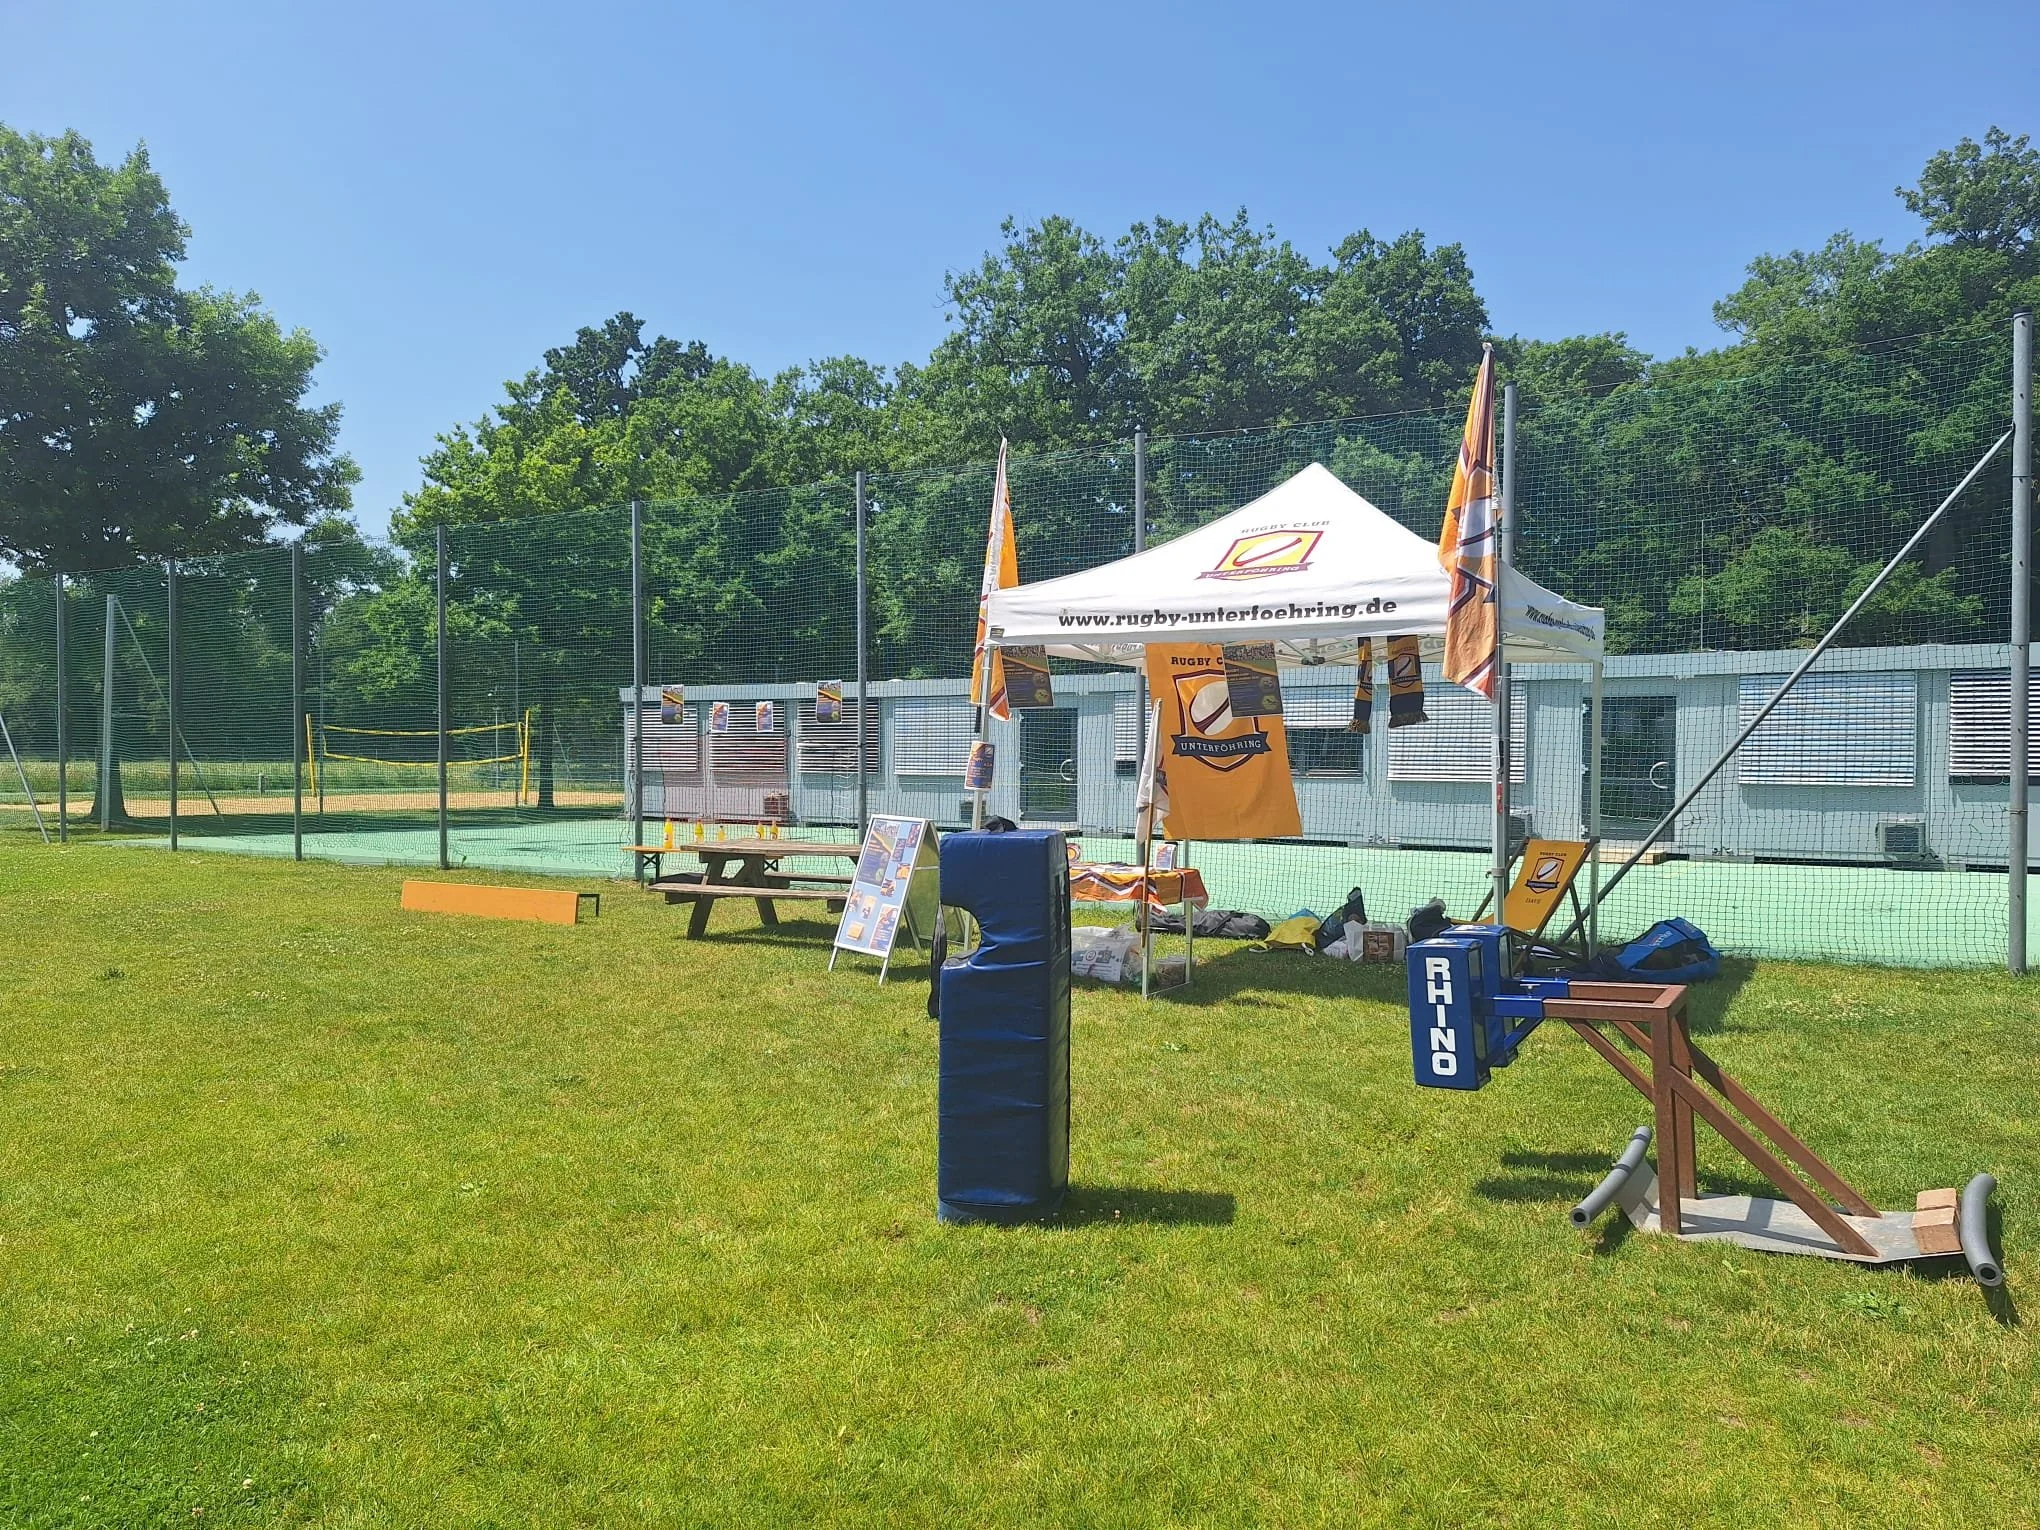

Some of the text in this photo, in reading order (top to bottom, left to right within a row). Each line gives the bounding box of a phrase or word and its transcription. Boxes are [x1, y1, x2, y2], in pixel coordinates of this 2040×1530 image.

[1241, 520, 1330, 533] RUGBY CLUB
[1059, 597, 1397, 627] www.rugby-unterfoehring.de
[1171, 656, 1212, 666] RUGBY
[1180, 740, 1261, 752] UNTERFÖHRING
[1425, 957, 1457, 1075] RHINO
